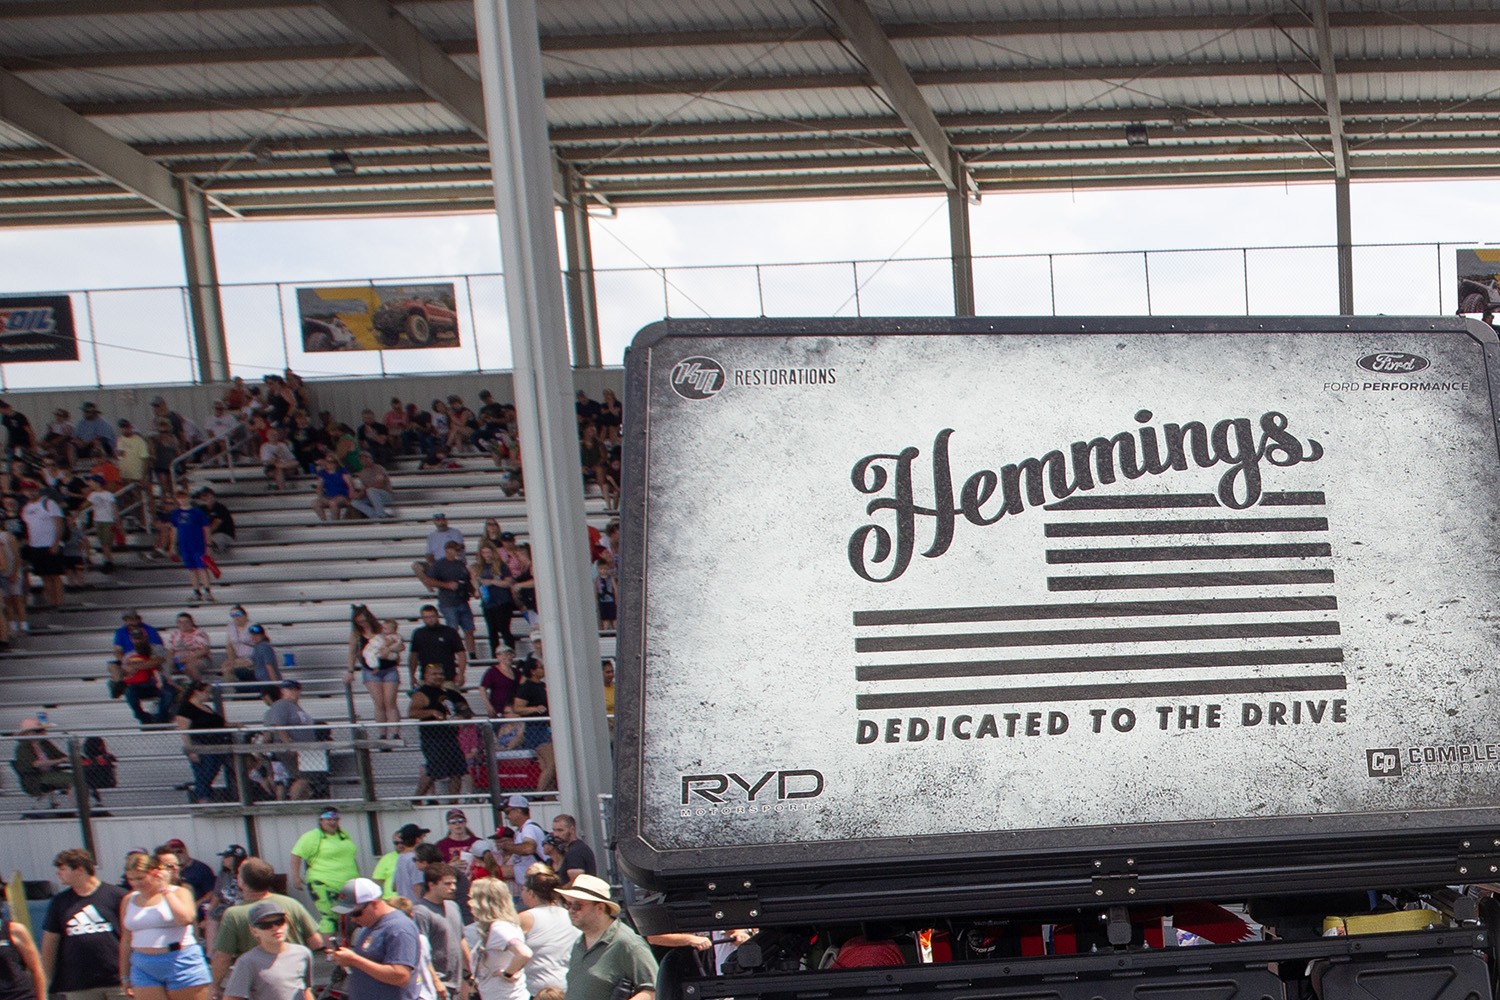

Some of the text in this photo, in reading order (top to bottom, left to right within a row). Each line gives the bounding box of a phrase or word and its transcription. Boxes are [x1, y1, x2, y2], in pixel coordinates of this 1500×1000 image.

[0, 308, 55, 334] OIL
[1372, 355, 1415, 371] Ford
[735, 368, 836, 386] RESTORATIONS
[1323, 382, 1469, 391] FORD PERFORMANCE
[847, 408, 1324, 582] Hemmings
[856, 699, 1348, 744] DEDICATED TO THE DRIVE
[681, 770, 825, 804] RYD
[680, 803, 823, 818] MOTORSPORTS
[65, 921, 113, 937] adidas
